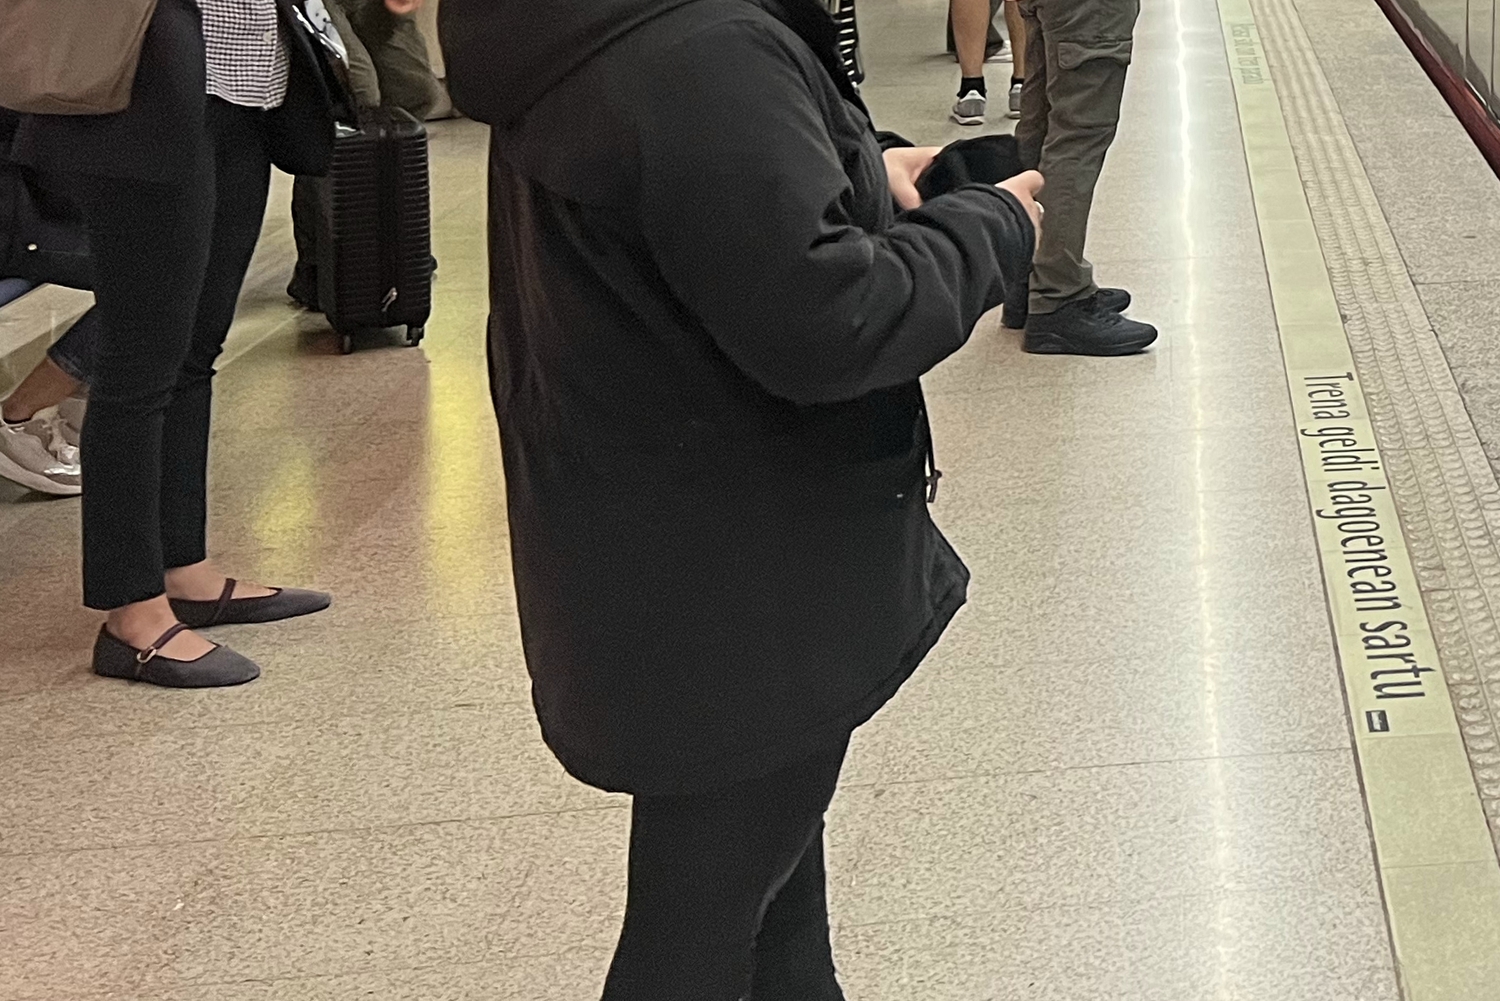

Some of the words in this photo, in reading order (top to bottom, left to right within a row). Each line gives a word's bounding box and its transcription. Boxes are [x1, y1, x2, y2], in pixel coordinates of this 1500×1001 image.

[1304, 372, 1354, 420] Trena
[1300, 426, 1380, 472] geldi
[1315, 481, 1402, 611] dagoenean
[1359, 620, 1437, 699] sartu
